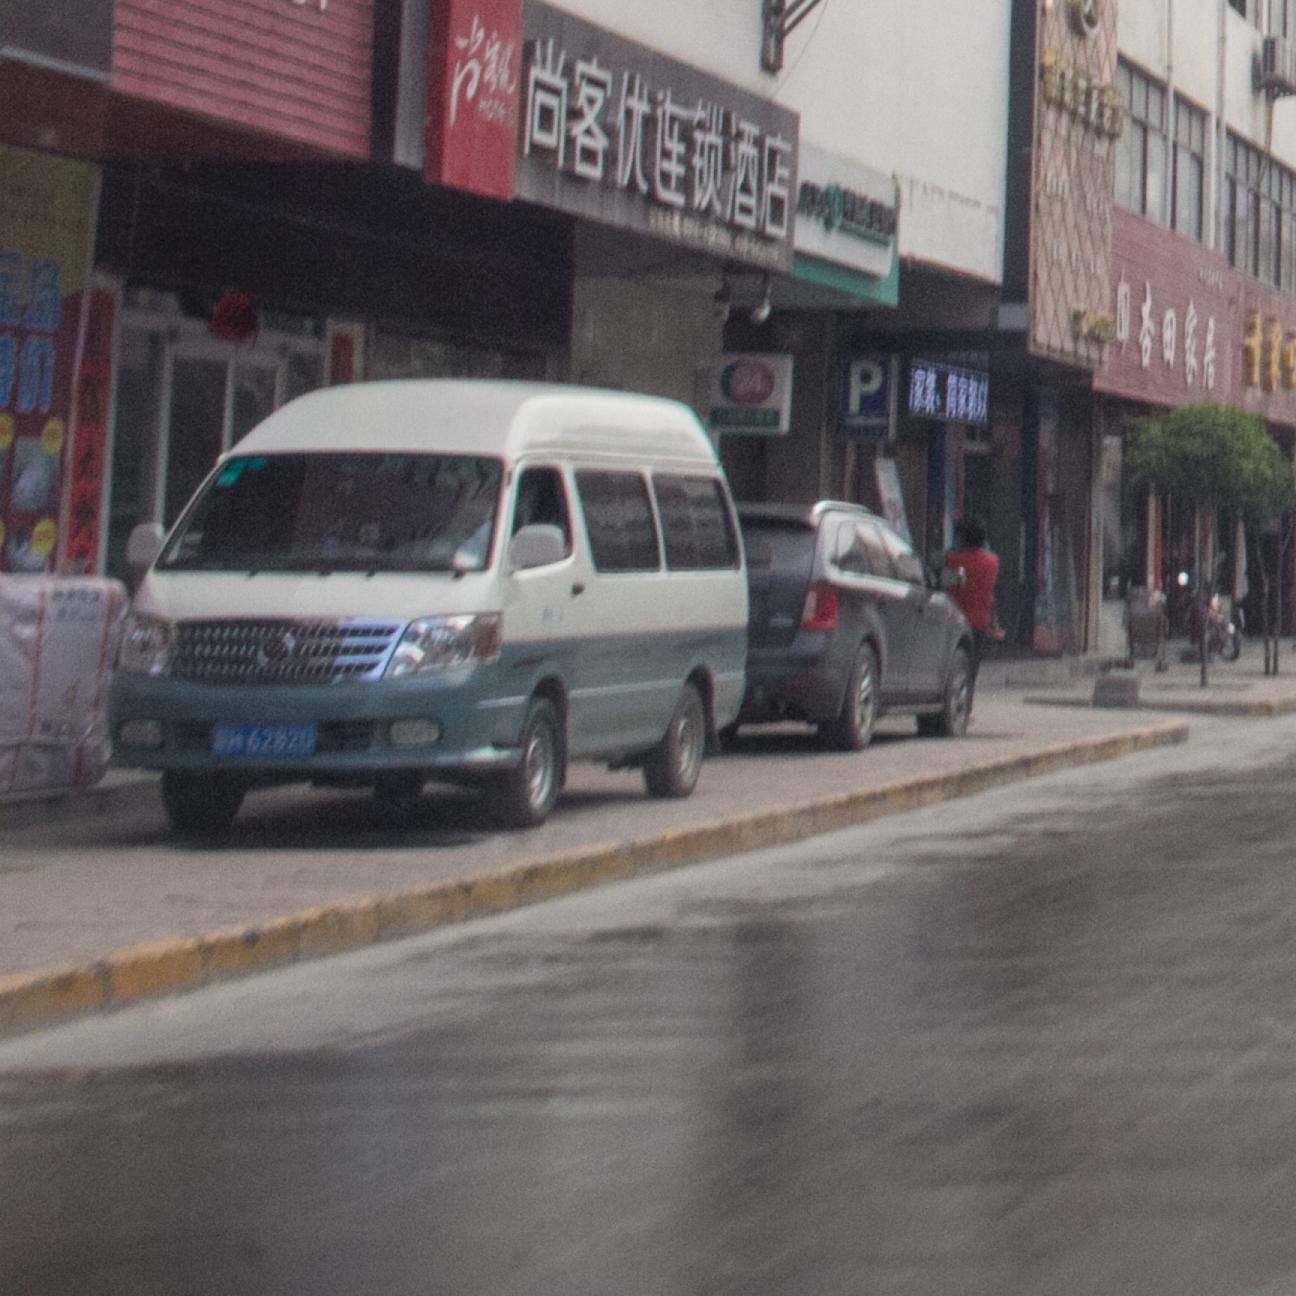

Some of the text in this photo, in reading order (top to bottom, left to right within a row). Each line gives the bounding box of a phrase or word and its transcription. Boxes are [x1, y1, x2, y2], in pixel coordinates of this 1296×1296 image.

[524, 36, 793, 240] 尚客优连锁酒店
[848, 359, 883, 417] P
